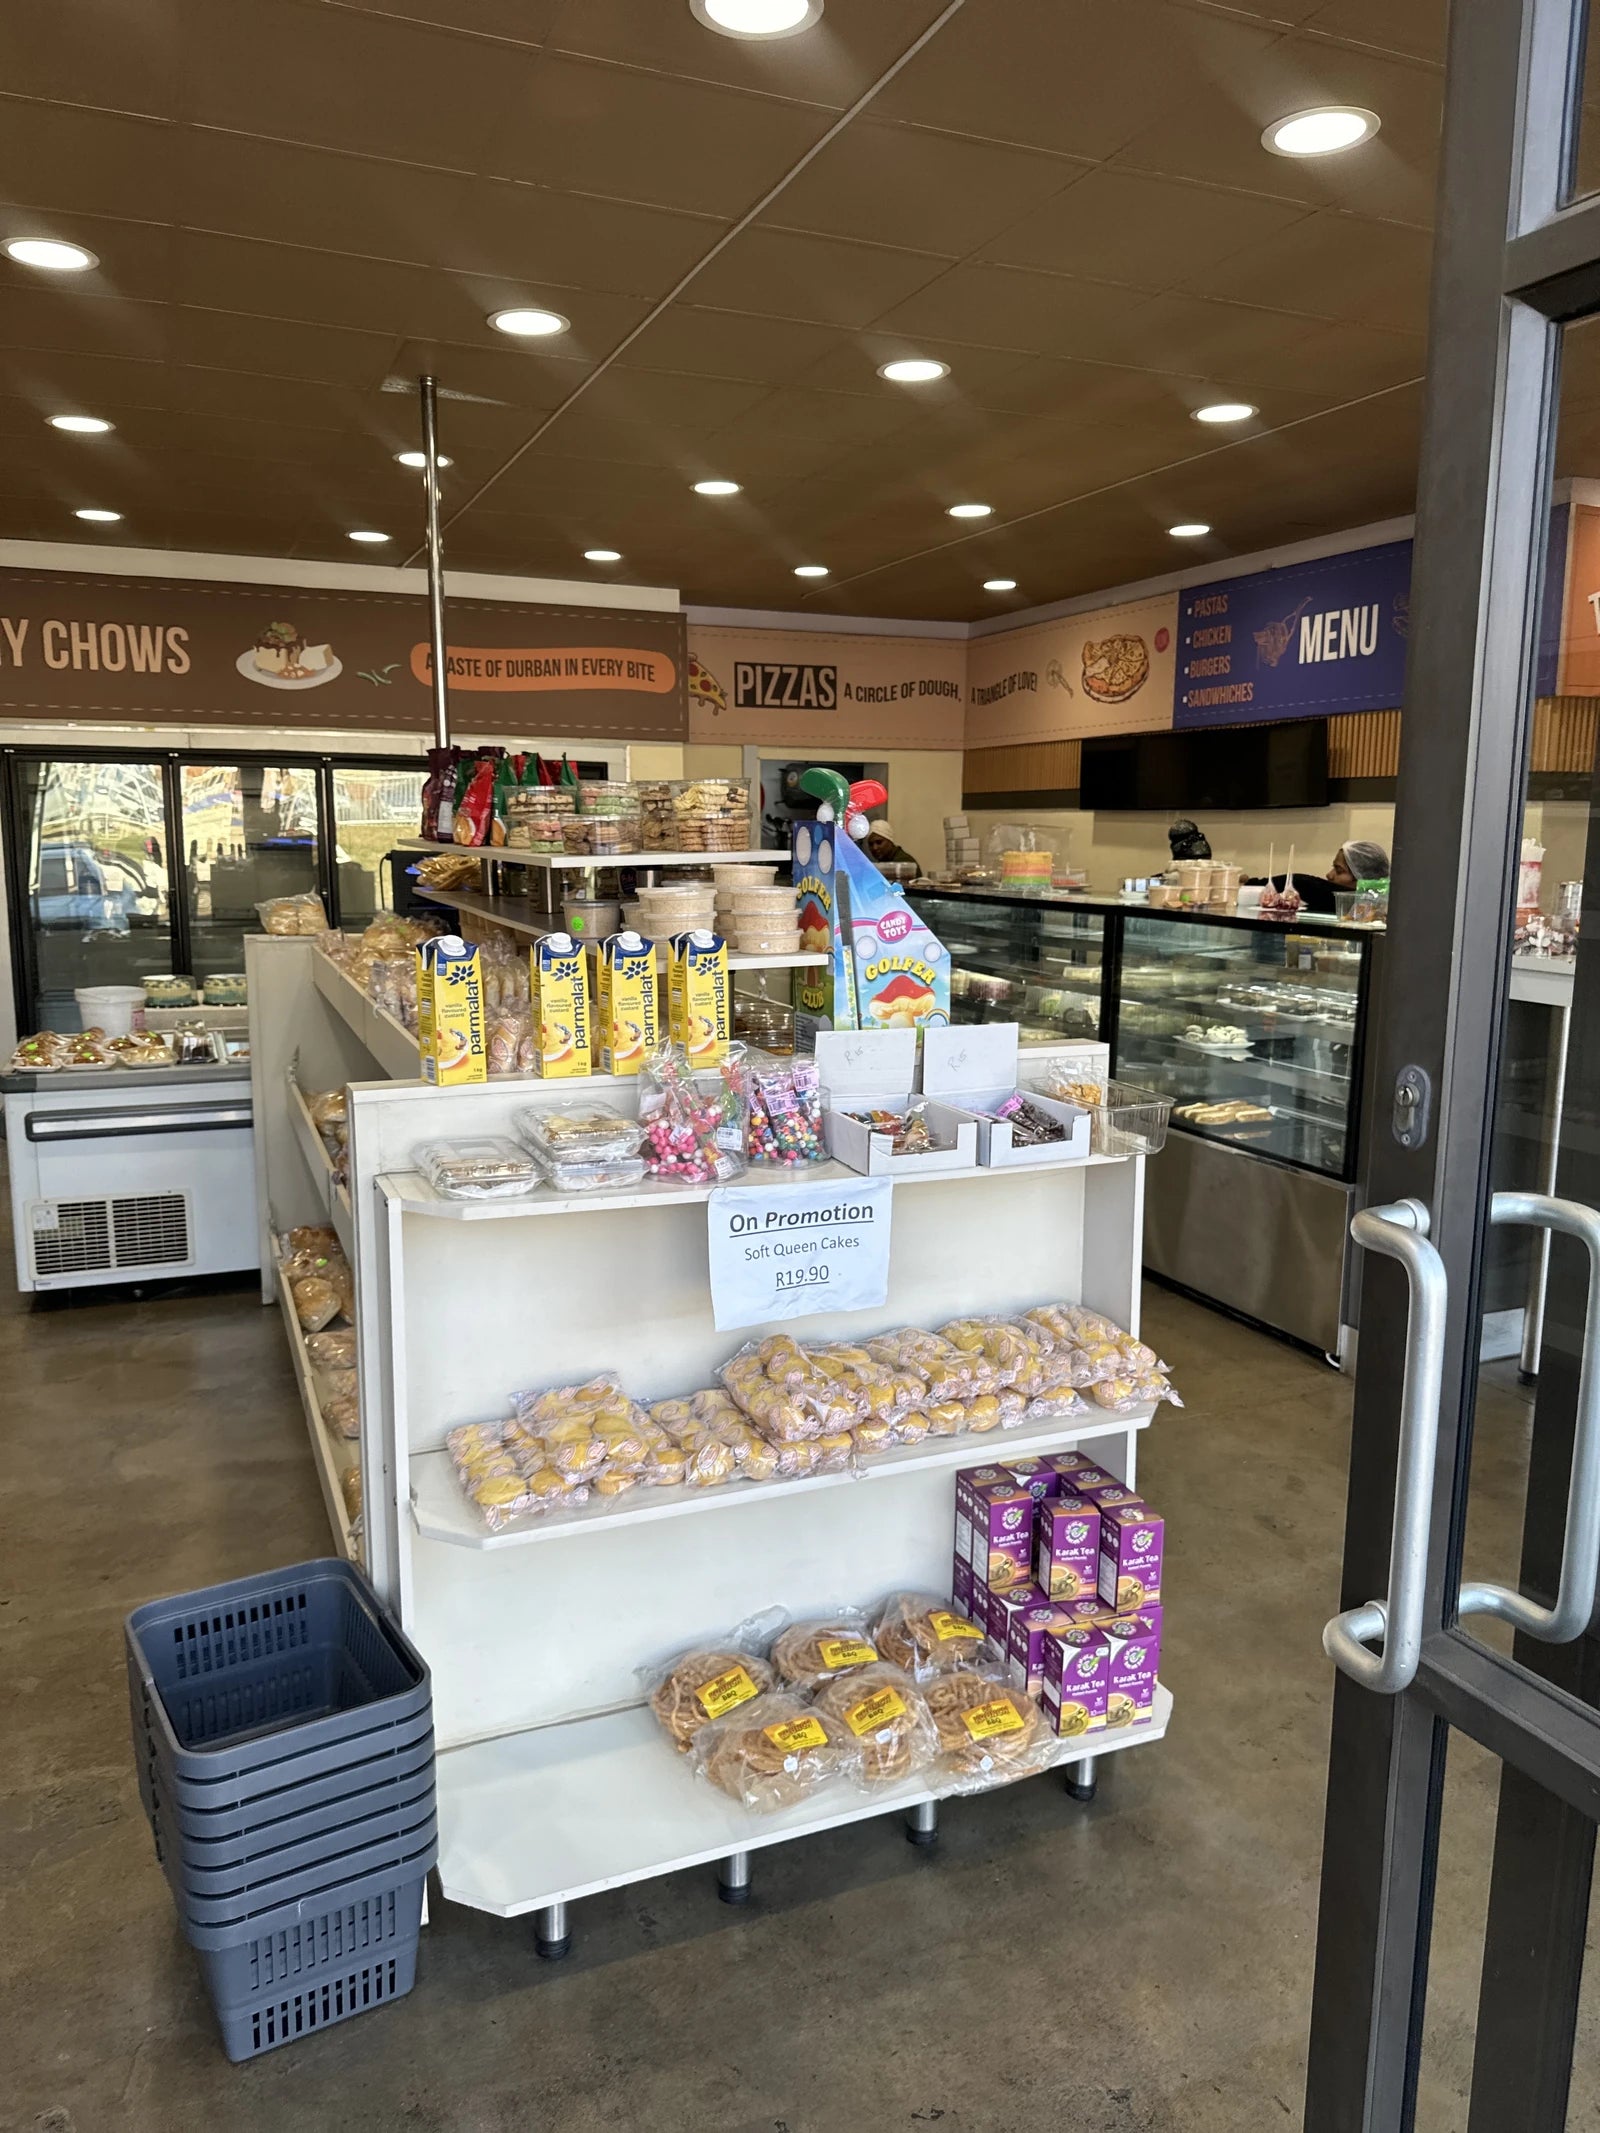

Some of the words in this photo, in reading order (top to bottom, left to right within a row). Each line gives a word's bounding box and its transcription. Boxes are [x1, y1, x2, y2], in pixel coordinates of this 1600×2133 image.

[1194, 594, 1229, 618] PASTAS
[1193, 625, 1232, 649] CHICKEN
[1299, 604, 1379, 664] MENU
[0, 618, 29, 667] Y
[42, 620, 191, 674] CHOWS
[447, 657, 481, 677] ASTE
[485, 659, 502, 678] OF
[506, 659, 561, 678] DURBAN
[565, 658, 578, 676] IN
[582, 658, 623, 677] EVERY
[627, 660, 656, 682] BITE
[1190, 655, 1231, 678] BURGERS
[736, 664, 835, 708] PIZZAS
[844, 682, 853, 700] A
[856, 685, 898, 704] CIRCLE
[901, 681, 916, 699] OF
[1187, 682, 1254, 708] SANDWHICHES
[879, 915, 907, 930] CANDY
[883, 925, 907, 939] TOYS
[865, 956, 936, 985] GOLFER
[640, 974, 656, 1046] parmalat
[712, 970, 728, 1040] parmalat
[802, 989, 824, 1009] CLUB
[465, 979, 484, 1055] parmalat
[570, 976, 588, 1049] parmalat
[729, 1214, 758, 1233] On
[765, 1203, 874, 1228] Promotion
[744, 1244, 770, 1260] Soft
[773, 1240, 817, 1257] Queen
[821, 1235, 860, 1250] Cakes
[776, 1265, 830, 1287] R19.90
[1016, 1531, 1029, 1539] Tea
[1080, 1547, 1095, 1555] Tea
[1145, 1554, 1159, 1563] Tea
[1091, 1680, 1105, 1688] Tea
[1137, 1671, 1152, 1679] Tea
[722, 1690, 737, 1701] BBQ
[868, 1708, 884, 1718] BBQ
[792, 1731, 808, 1740] BBQ
